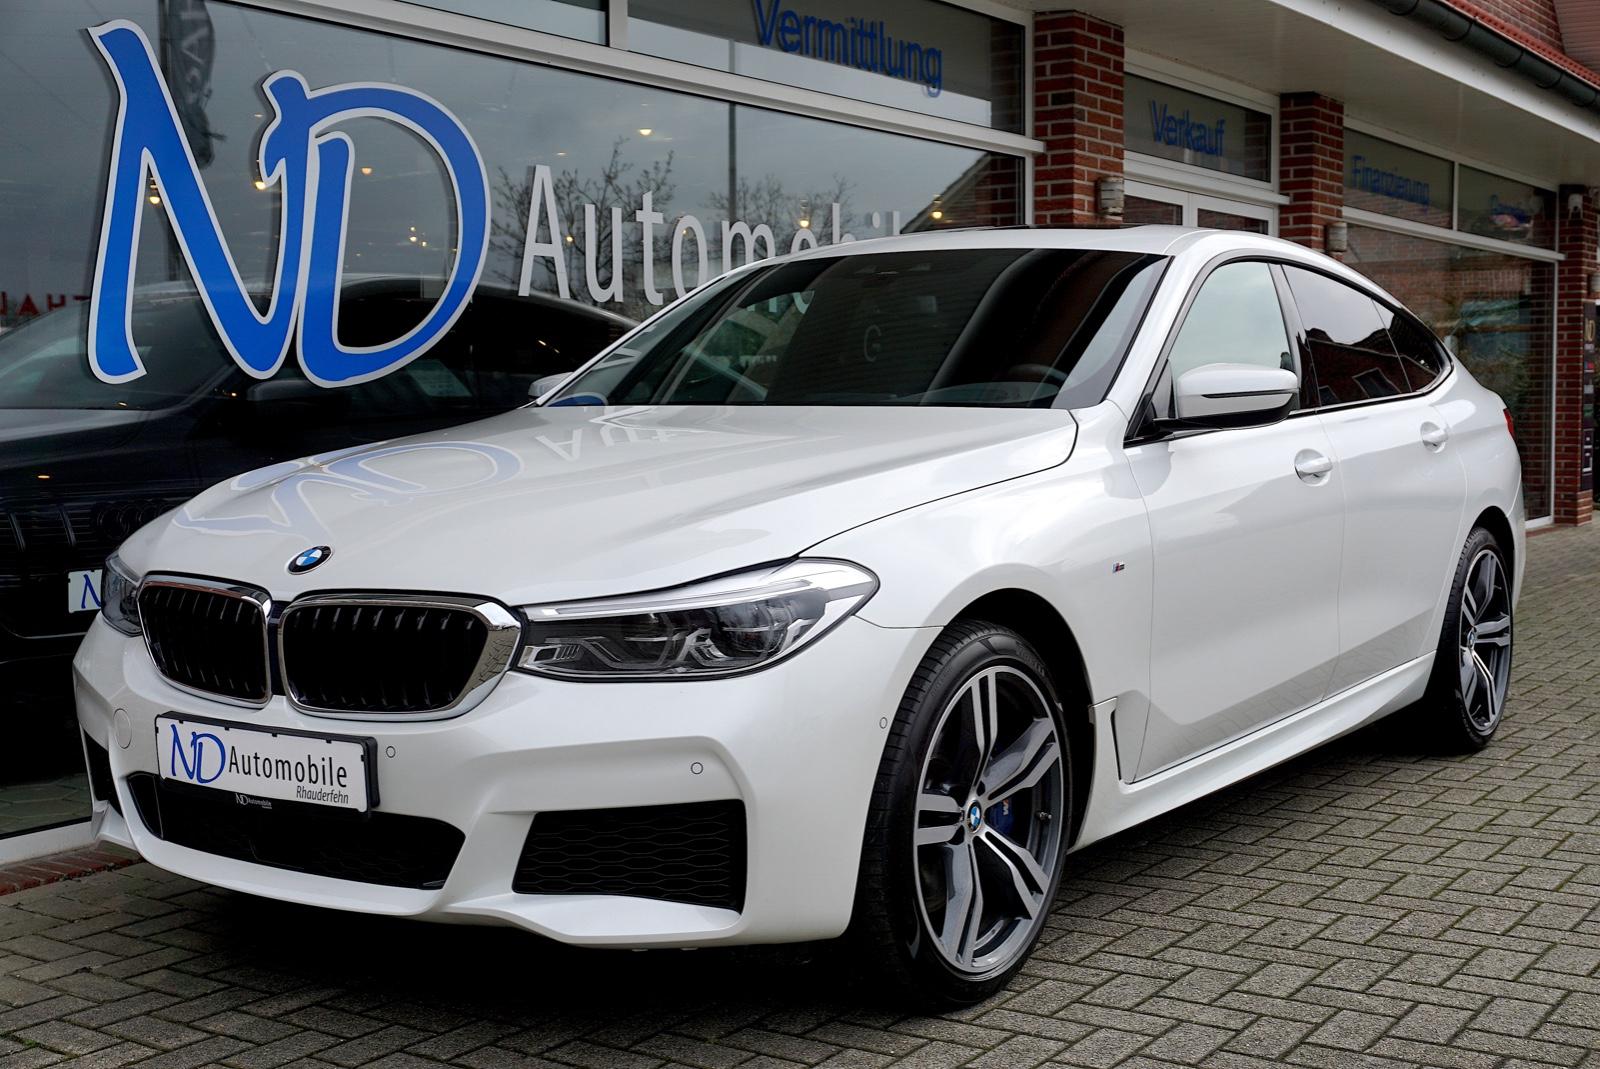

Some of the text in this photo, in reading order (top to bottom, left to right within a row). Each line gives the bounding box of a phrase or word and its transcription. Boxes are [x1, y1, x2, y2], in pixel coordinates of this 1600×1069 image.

[754, 0, 942, 97] Vermittlung
[1151, 100, 1226, 157] Verkauf
[88, 19, 491, 388] ND
[170, 723, 348, 788] ND Automobile
[295, 785, 349, 804] Rhauderfehn
